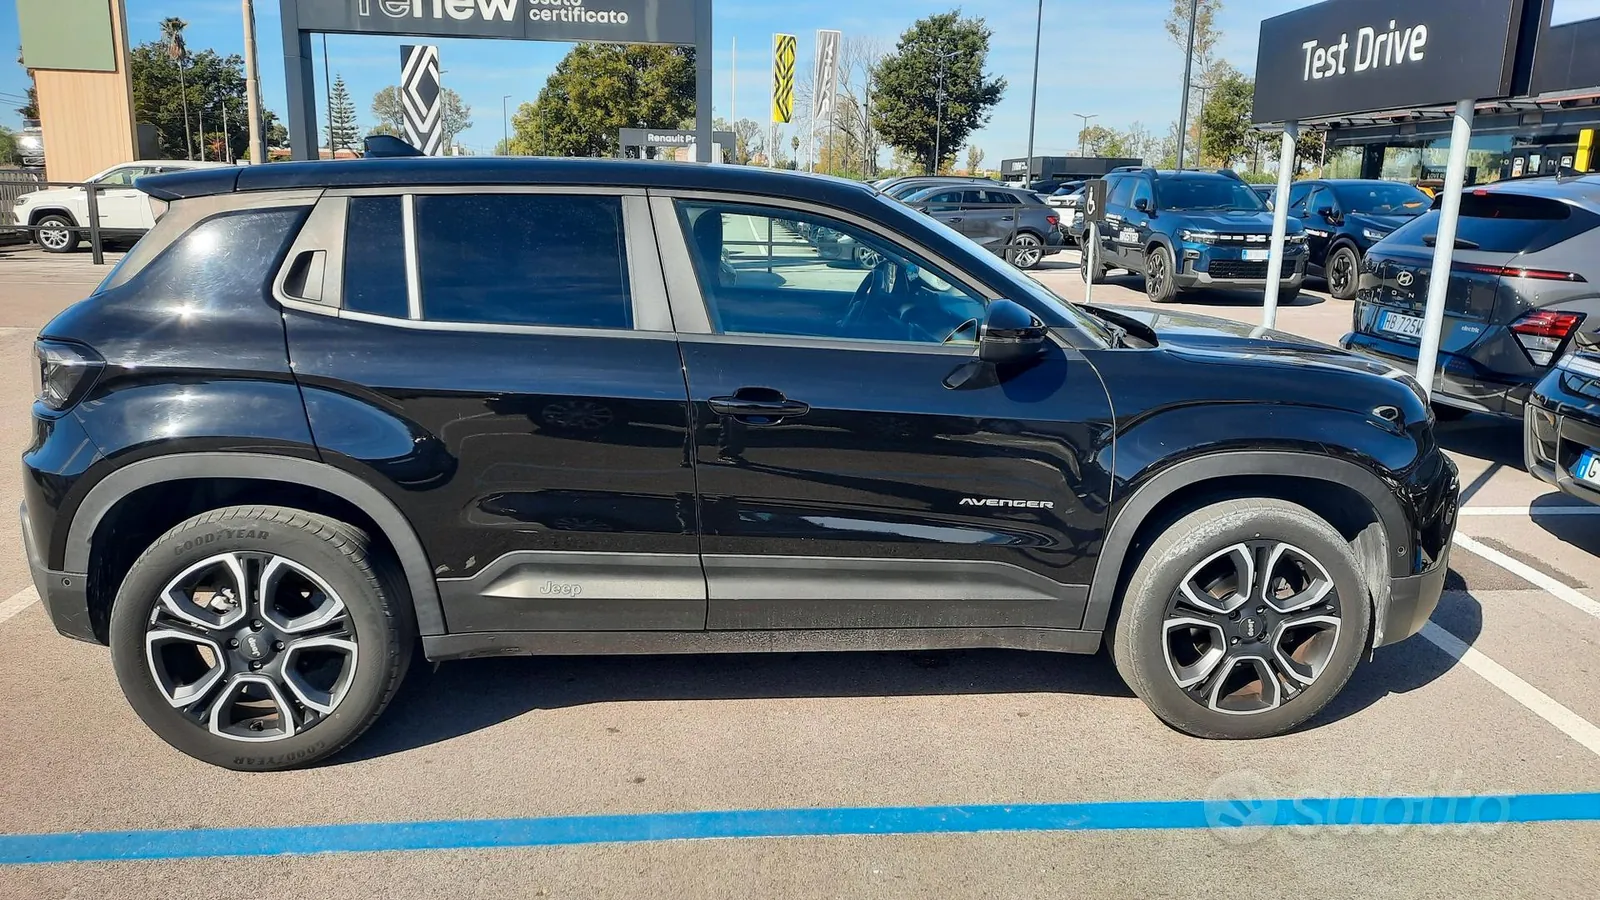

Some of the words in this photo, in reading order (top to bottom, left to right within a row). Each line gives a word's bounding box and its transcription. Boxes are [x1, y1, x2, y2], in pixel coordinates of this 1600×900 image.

[529, 7, 628, 24] certificato
[1302, 33, 1348, 81] Test
[1354, 19, 1427, 72] Drive
[647, 133, 684, 143] Renault
[686, 134, 696, 143] Pr
[1385, 313, 1398, 330] HB
[1398, 316, 1425, 335] 725W
[1461, 325, 1480, 334] electric
[959, 498, 1054, 509] AVENGER
[174, 529, 270, 556] GOODYEAR
[539, 580, 583, 597] Jeep
[247, 637, 261, 657] Jeep
